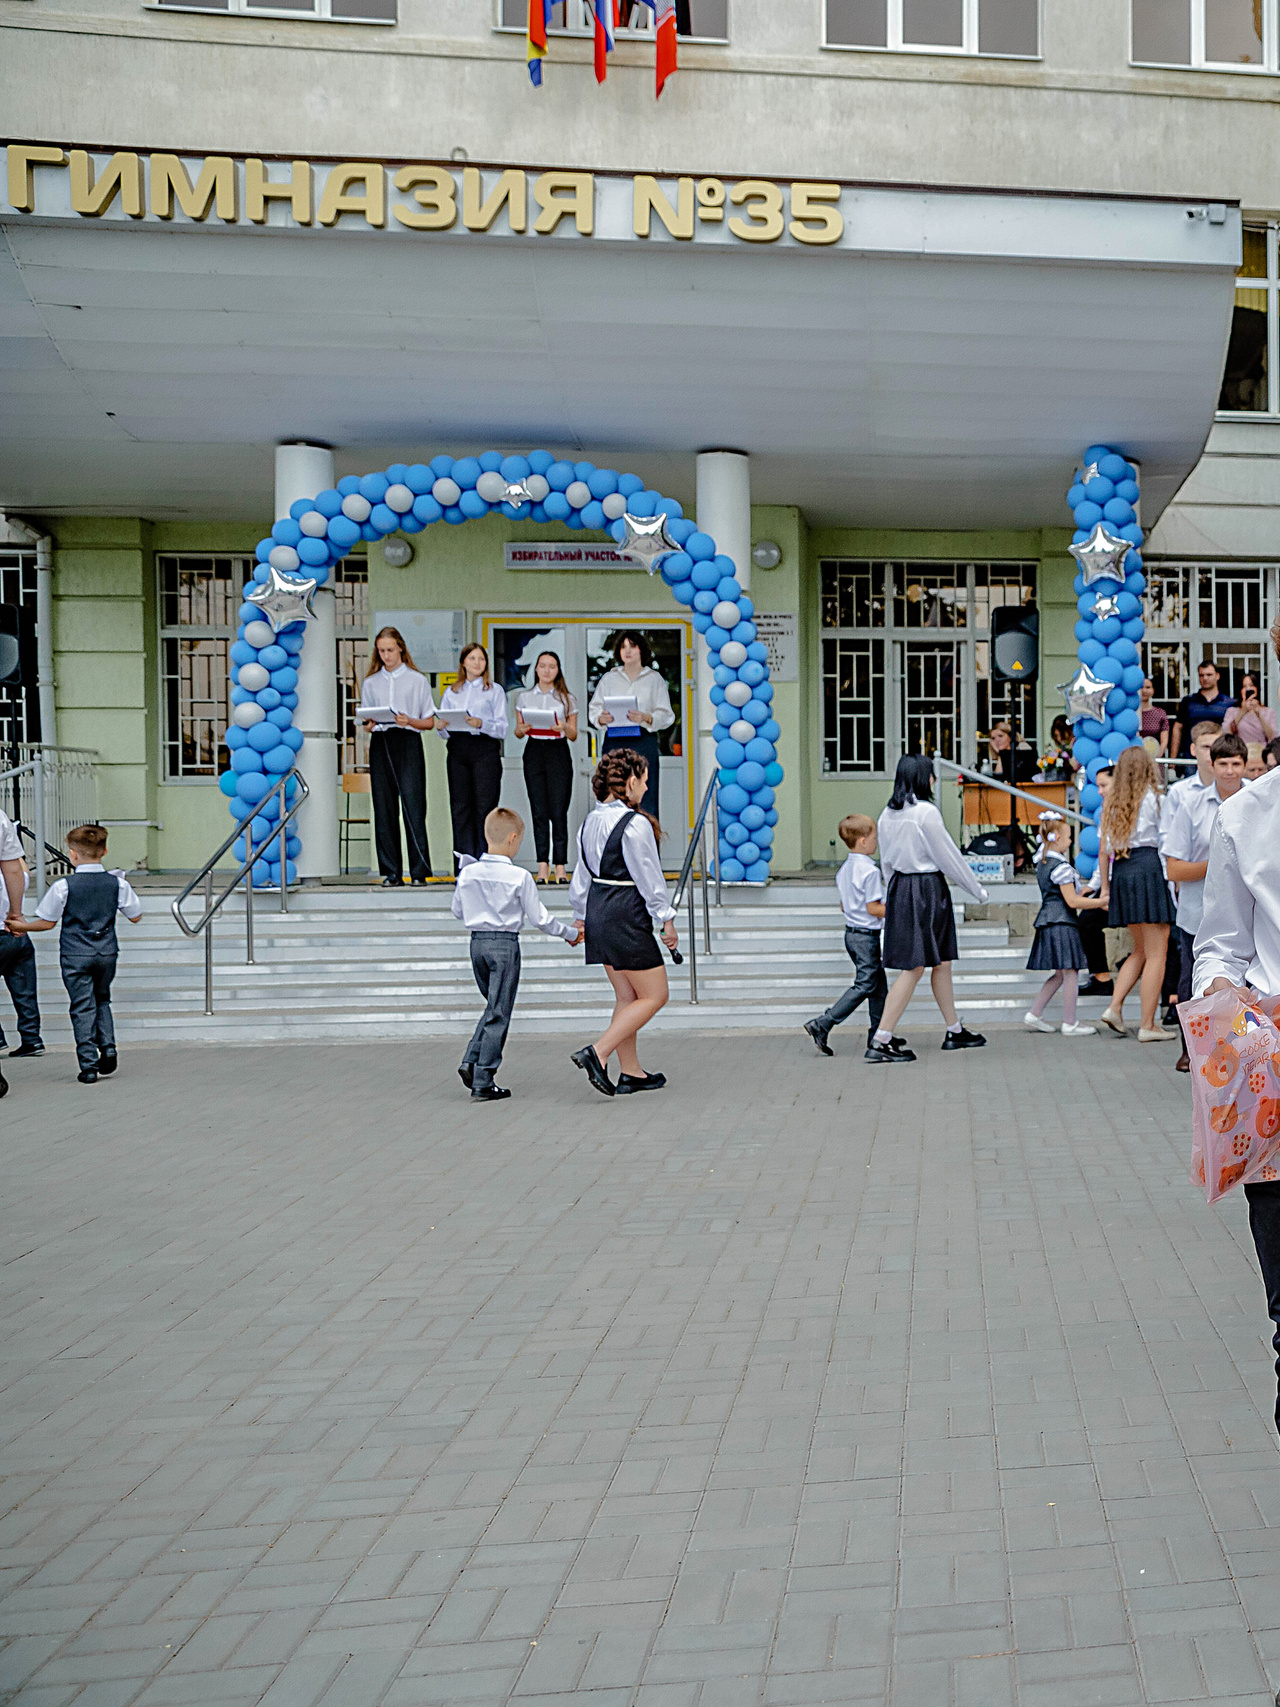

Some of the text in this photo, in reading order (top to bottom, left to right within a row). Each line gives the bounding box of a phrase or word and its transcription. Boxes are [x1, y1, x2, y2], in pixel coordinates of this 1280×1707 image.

[6, 143, 844, 244] ГИМНАЗИЯ №35
[511, 549, 583, 561] ИЗБИРАТЕЛЬНЫЙ
